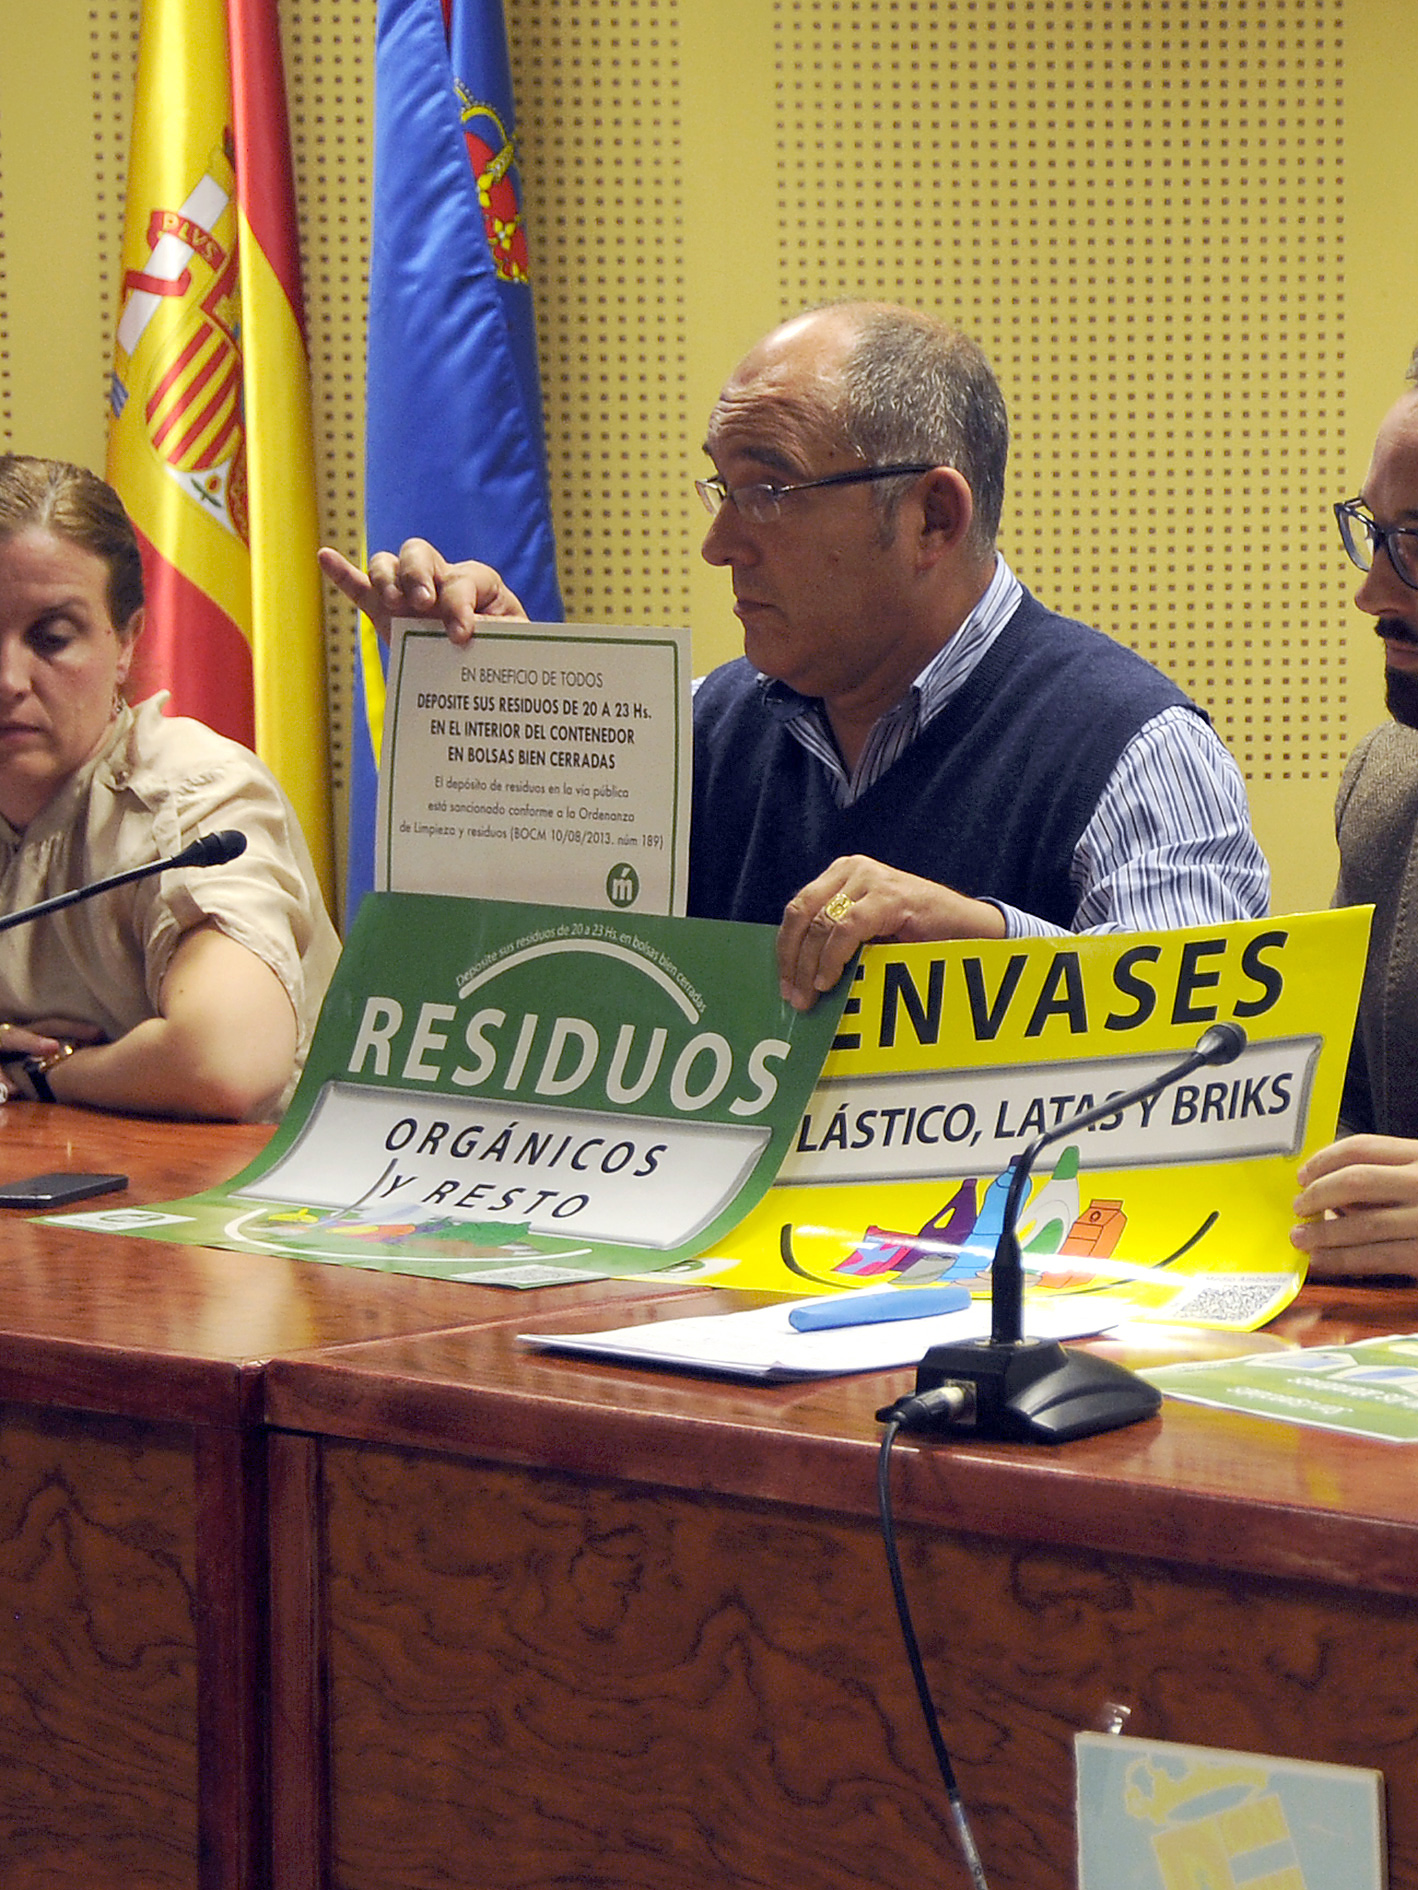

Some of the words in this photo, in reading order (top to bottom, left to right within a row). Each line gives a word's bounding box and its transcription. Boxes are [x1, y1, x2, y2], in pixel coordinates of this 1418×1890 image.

[461, 667, 476, 682] EN
[480, 668, 538, 685] BENEFICIO
[542, 671, 557, 686] DE
[561, 671, 603, 688] TODOS
[417, 693, 469, 711] DEPOSITE
[473, 695, 495, 712] SUS
[499, 697, 559, 715] RESIDUOS
[563, 700, 578, 716] DE
[582, 701, 598, 716] 20
[601, 702, 611, 717] A
[615, 703, 629, 718] 23
[633, 703, 652, 719] Hs.
[430, 719, 445, 735] EN
[449, 720, 461, 736] EL
[465, 721, 520, 739] INTERIOR
[525, 724, 546, 740] DEL
[550, 725, 635, 744] CONTENEDOR
[448, 746, 463, 762] EN
[468, 747, 514, 765] BOLSAS
[518, 749, 546, 766] BIEN
[550, 751, 616, 769] CERRADAS
[435, 775, 443, 789] El
[446, 776, 487, 792] depósito
[490, 779, 502, 791] de
[505, 780, 545, 794] residuos
[548, 785, 560, 795] en
[563, 782, 573, 795] la
[593, 784, 629, 800] pública
[428, 800, 447, 812] está
[450, 801, 505, 815] sancionado
[508, 803, 553, 818] conforme
[556, 810, 563, 819] a
[566, 806, 576, 819] la
[578, 807, 635, 822] Ordenanza
[400, 820, 411, 833] de
[414, 821, 456, 838] Limpieza
[459, 828, 464, 839] y
[467, 824, 507, 840] residuos
[510, 826, 547, 842] (BOCM
[642, 833, 664, 850] 189)
[455, 951, 498, 988] Deposite
[499, 942, 515, 958] sus
[516, 928, 556, 949] residuos
[556, 924, 570, 936] de
[571, 923, 584, 936] 20
[584, 925, 591, 935] a
[592, 924, 603, 936] 23
[619, 932, 632, 945] en
[632, 934, 659, 961] bolsas
[659, 952, 678, 977] bien
[676, 972, 707, 1014] cerradas
[347, 996, 792, 1117] RESIDUOS
[796, 1103, 983, 1153] LÁSTICO,
[1171, 1072, 1293, 1127] BRIKS
[385, 1120, 668, 1177] ORGÁNICOS
[380, 1174, 419, 1199] Y
[421, 1179, 591, 1219] RESTO
